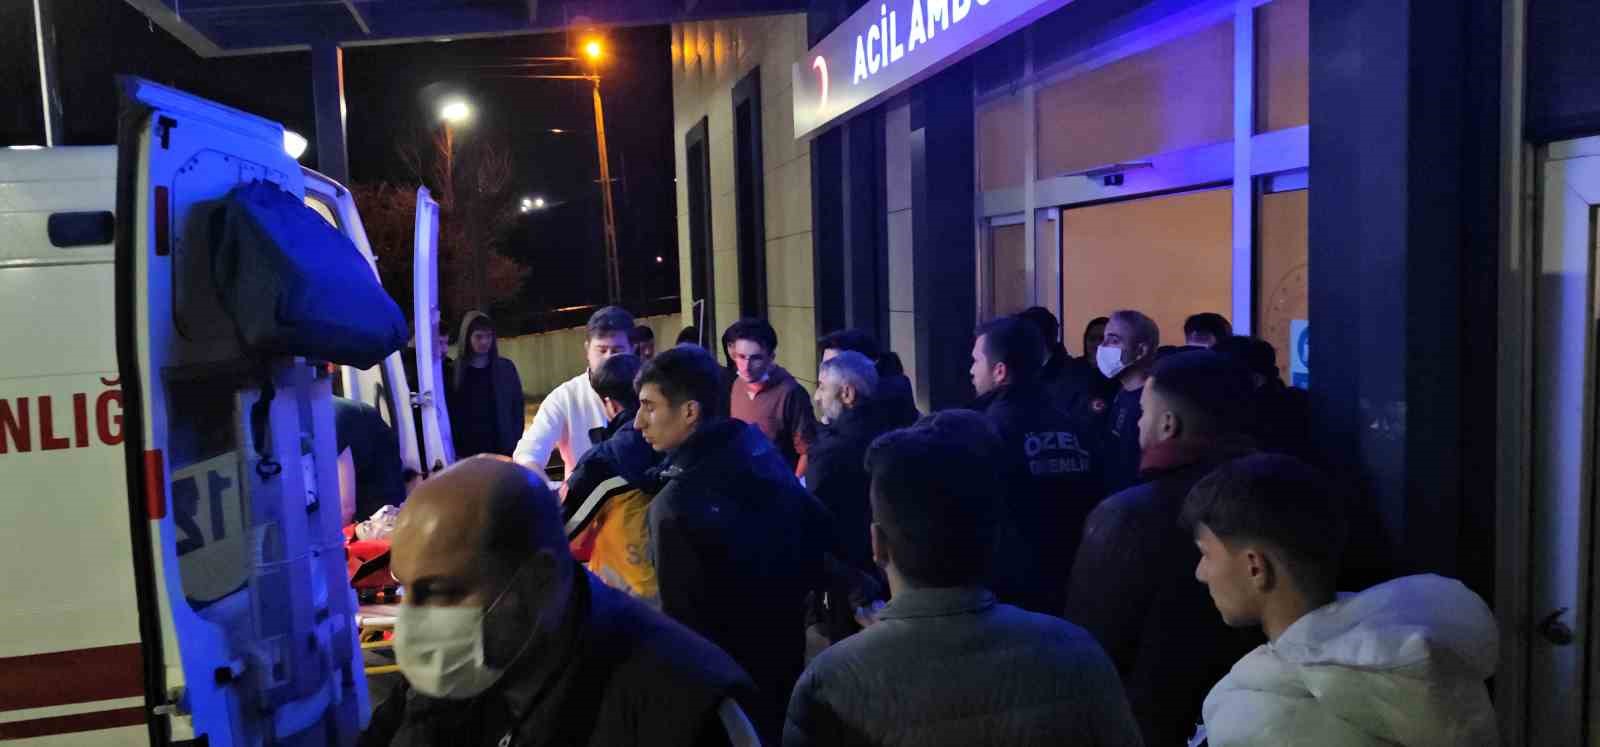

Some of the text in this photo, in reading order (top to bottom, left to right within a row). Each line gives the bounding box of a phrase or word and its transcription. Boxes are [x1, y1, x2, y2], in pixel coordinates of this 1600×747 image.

[853, 0, 990, 85] ACİL AM
[1024, 431, 1089, 457] ÖZEL
